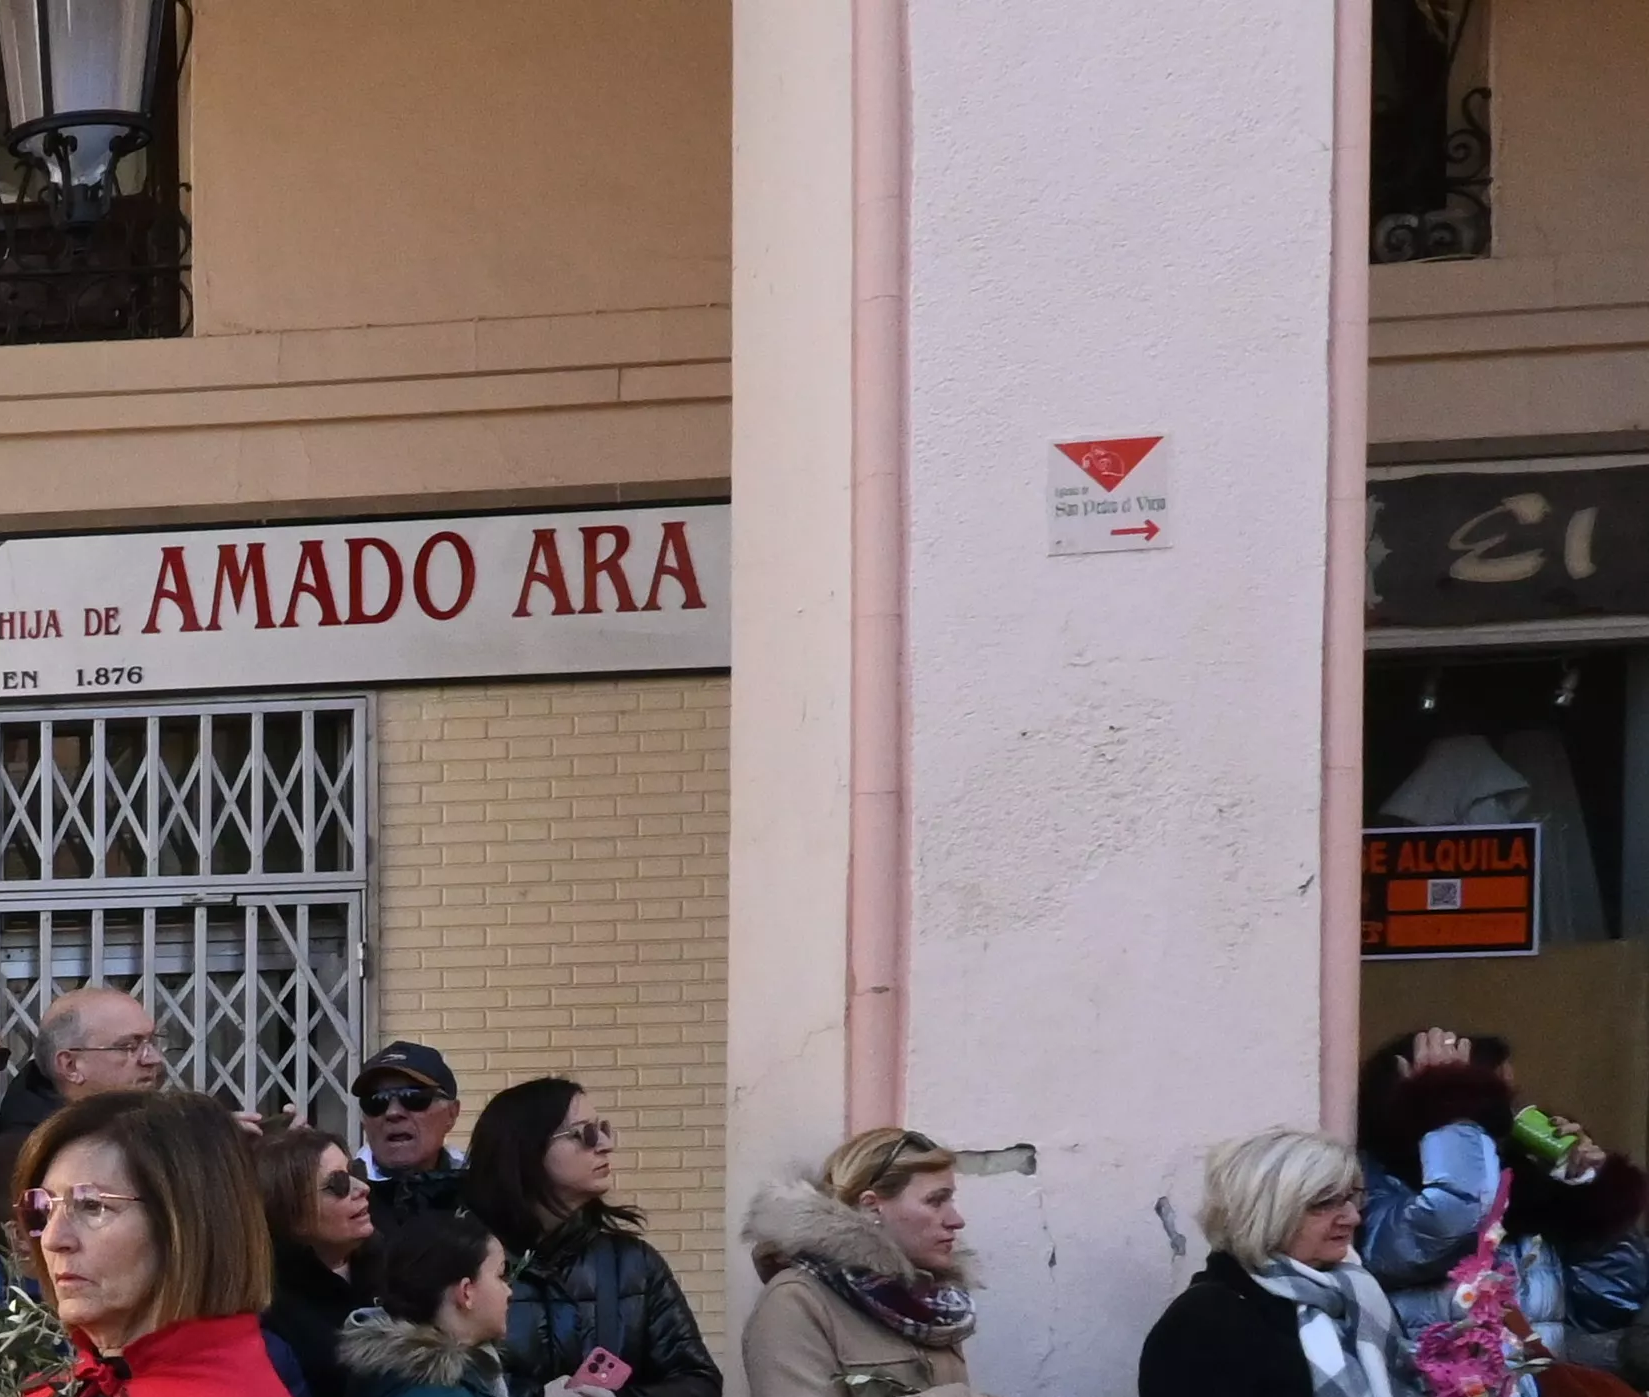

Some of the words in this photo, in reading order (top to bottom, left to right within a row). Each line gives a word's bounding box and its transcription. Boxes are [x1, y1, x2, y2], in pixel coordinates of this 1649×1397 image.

[83, 606, 122, 639] DE
[140, 531, 477, 635] AMADO
[511, 520, 708, 618] ARA
[2, 670, 39, 691] EN
[75, 665, 144, 688] 1.876
[1398, 836, 1528, 873] ALQUILA
